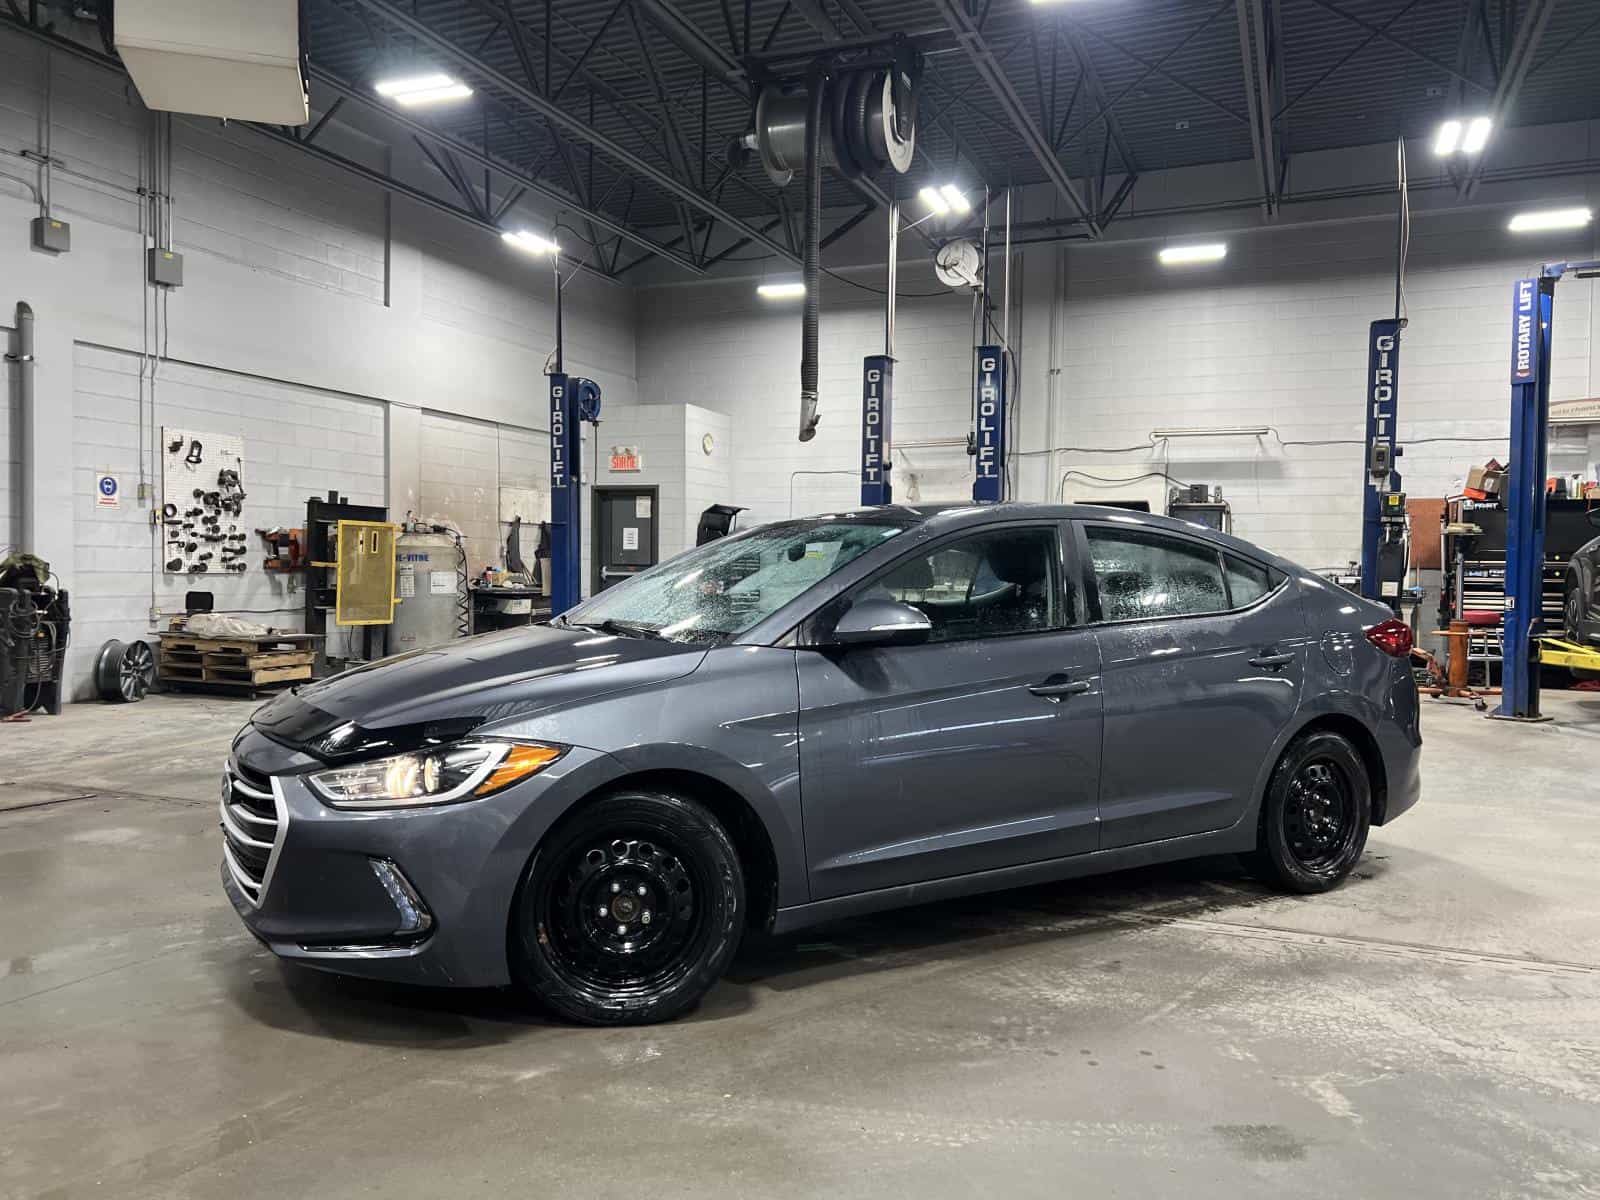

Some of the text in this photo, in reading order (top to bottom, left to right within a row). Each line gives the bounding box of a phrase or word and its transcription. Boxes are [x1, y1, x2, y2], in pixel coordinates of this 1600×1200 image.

[1517, 281, 1533, 370] ROTARY LIFT
[552, 386, 564, 485] GIROLIFT
[866, 369, 881, 481] GIROLIFT
[979, 357, 996, 475] GIROLIFT
[1374, 335, 1393, 447] GIROLIF
